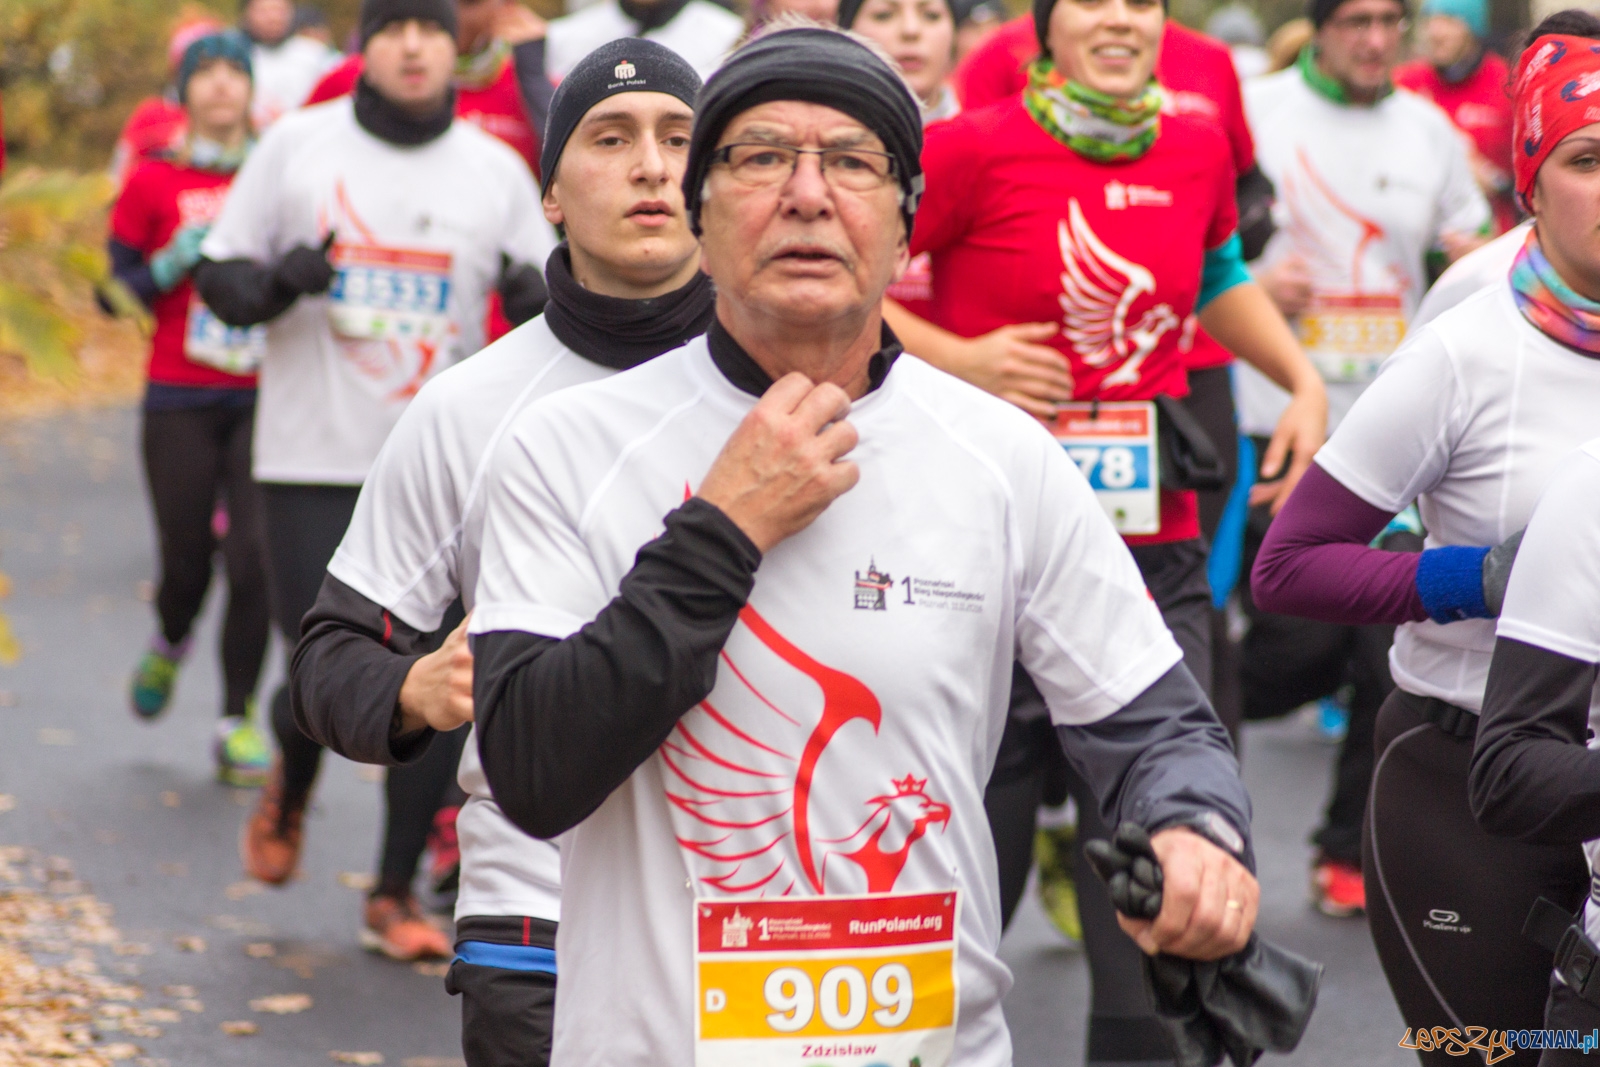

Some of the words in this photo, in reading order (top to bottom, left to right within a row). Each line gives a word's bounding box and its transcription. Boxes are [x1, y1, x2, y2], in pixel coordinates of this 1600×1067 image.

[901, 576, 916, 605] 1
[757, 917, 771, 941] 1
[849, 914, 943, 935] RunPoland.org
[705, 988, 727, 1012] D
[763, 963, 913, 1032] 909
[801, 1043, 877, 1058] Zdzisław
